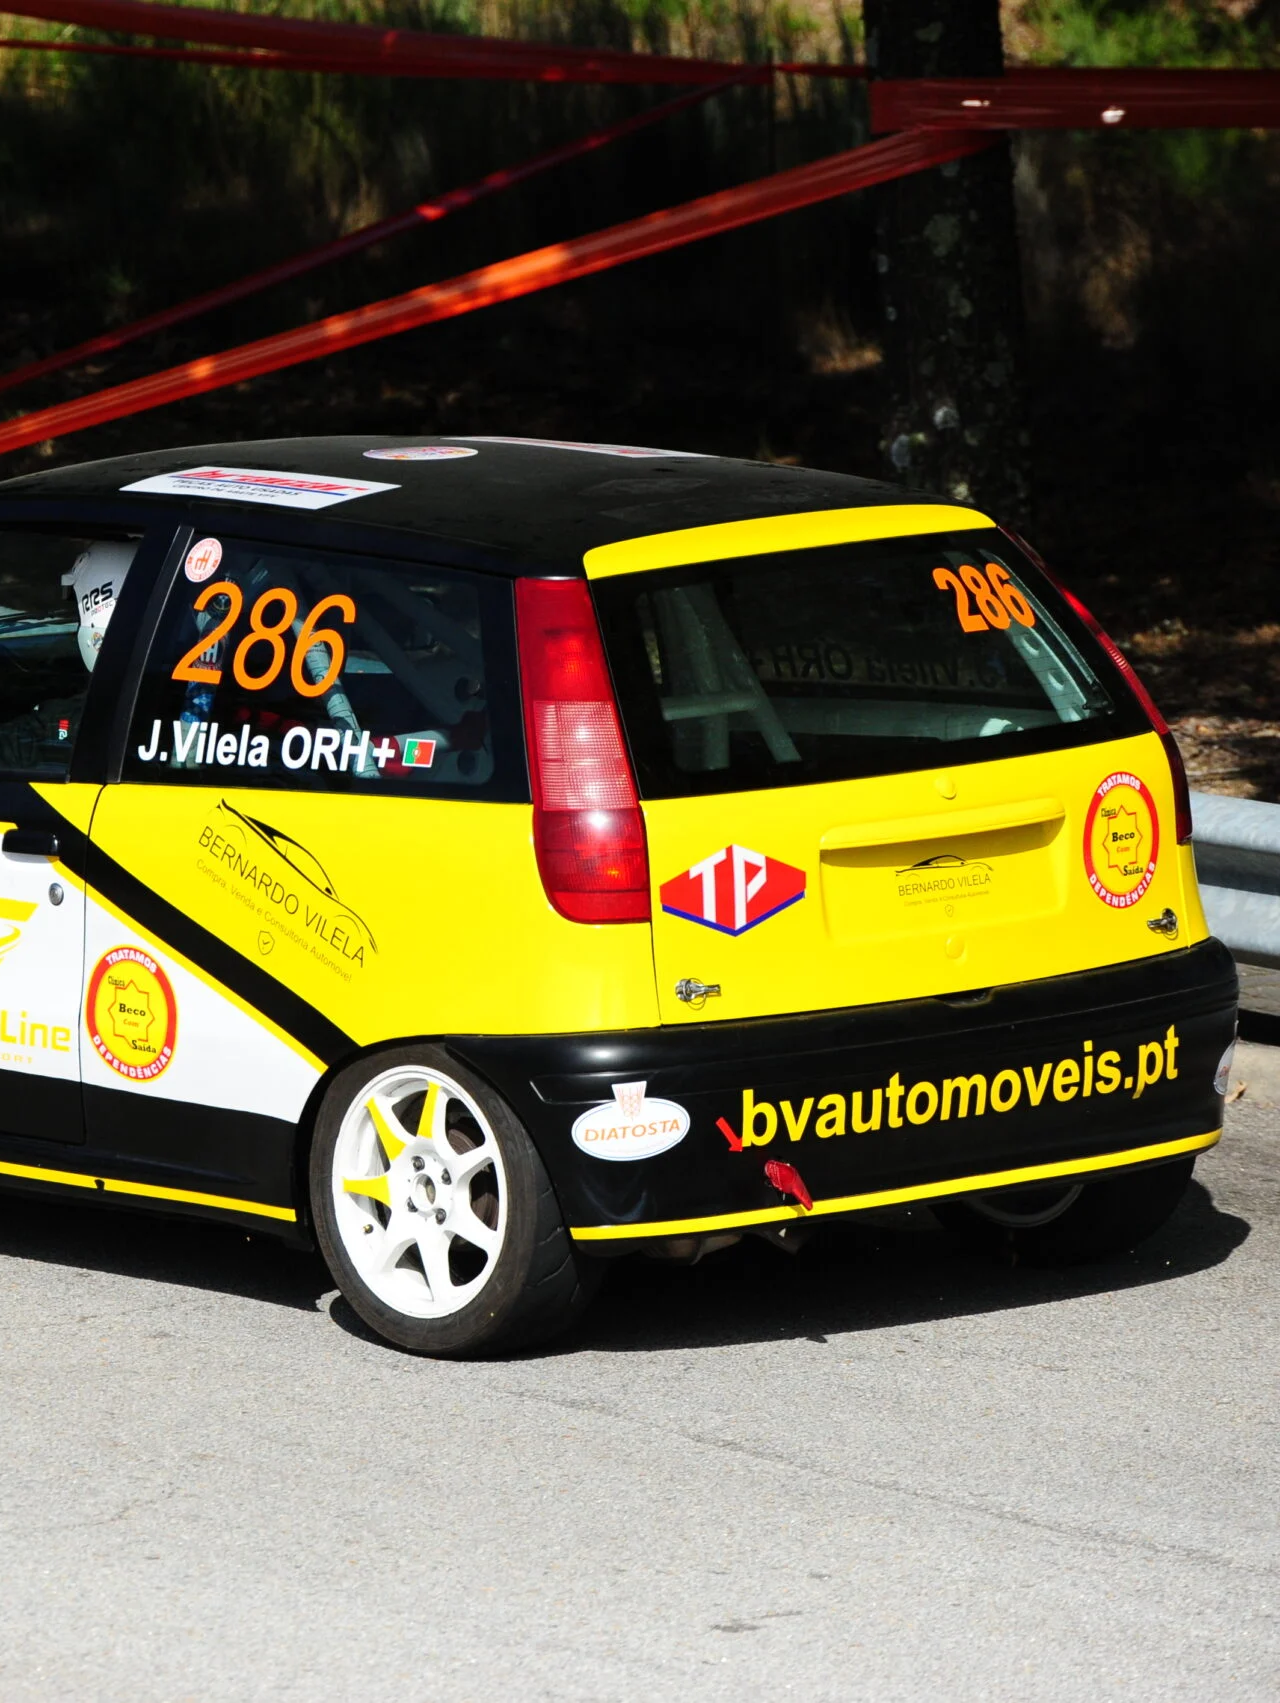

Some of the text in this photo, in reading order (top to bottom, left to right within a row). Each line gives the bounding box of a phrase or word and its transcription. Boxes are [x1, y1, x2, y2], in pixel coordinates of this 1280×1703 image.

[82, 581, 113, 614] RRS
[932, 562, 1036, 632] 286
[172, 581, 356, 698] 286
[137, 720, 269, 768] J.Vilela
[1097, 773, 1141, 797] TRATAMOS
[1111, 831, 1136, 843] Beco
[198, 825, 365, 969] BERNARDO VILELA
[230, 884, 256, 911] Venda
[689, 843, 767, 931] TP
[898, 873, 992, 897] BERNARDO VILELA
[105, 949, 158, 974] TRATAMOS
[118, 1003, 147, 1017] Beco
[742, 1025, 1180, 1149] bvautomoveis.pt
[583, 1118, 681, 1142] DIATOSTA
